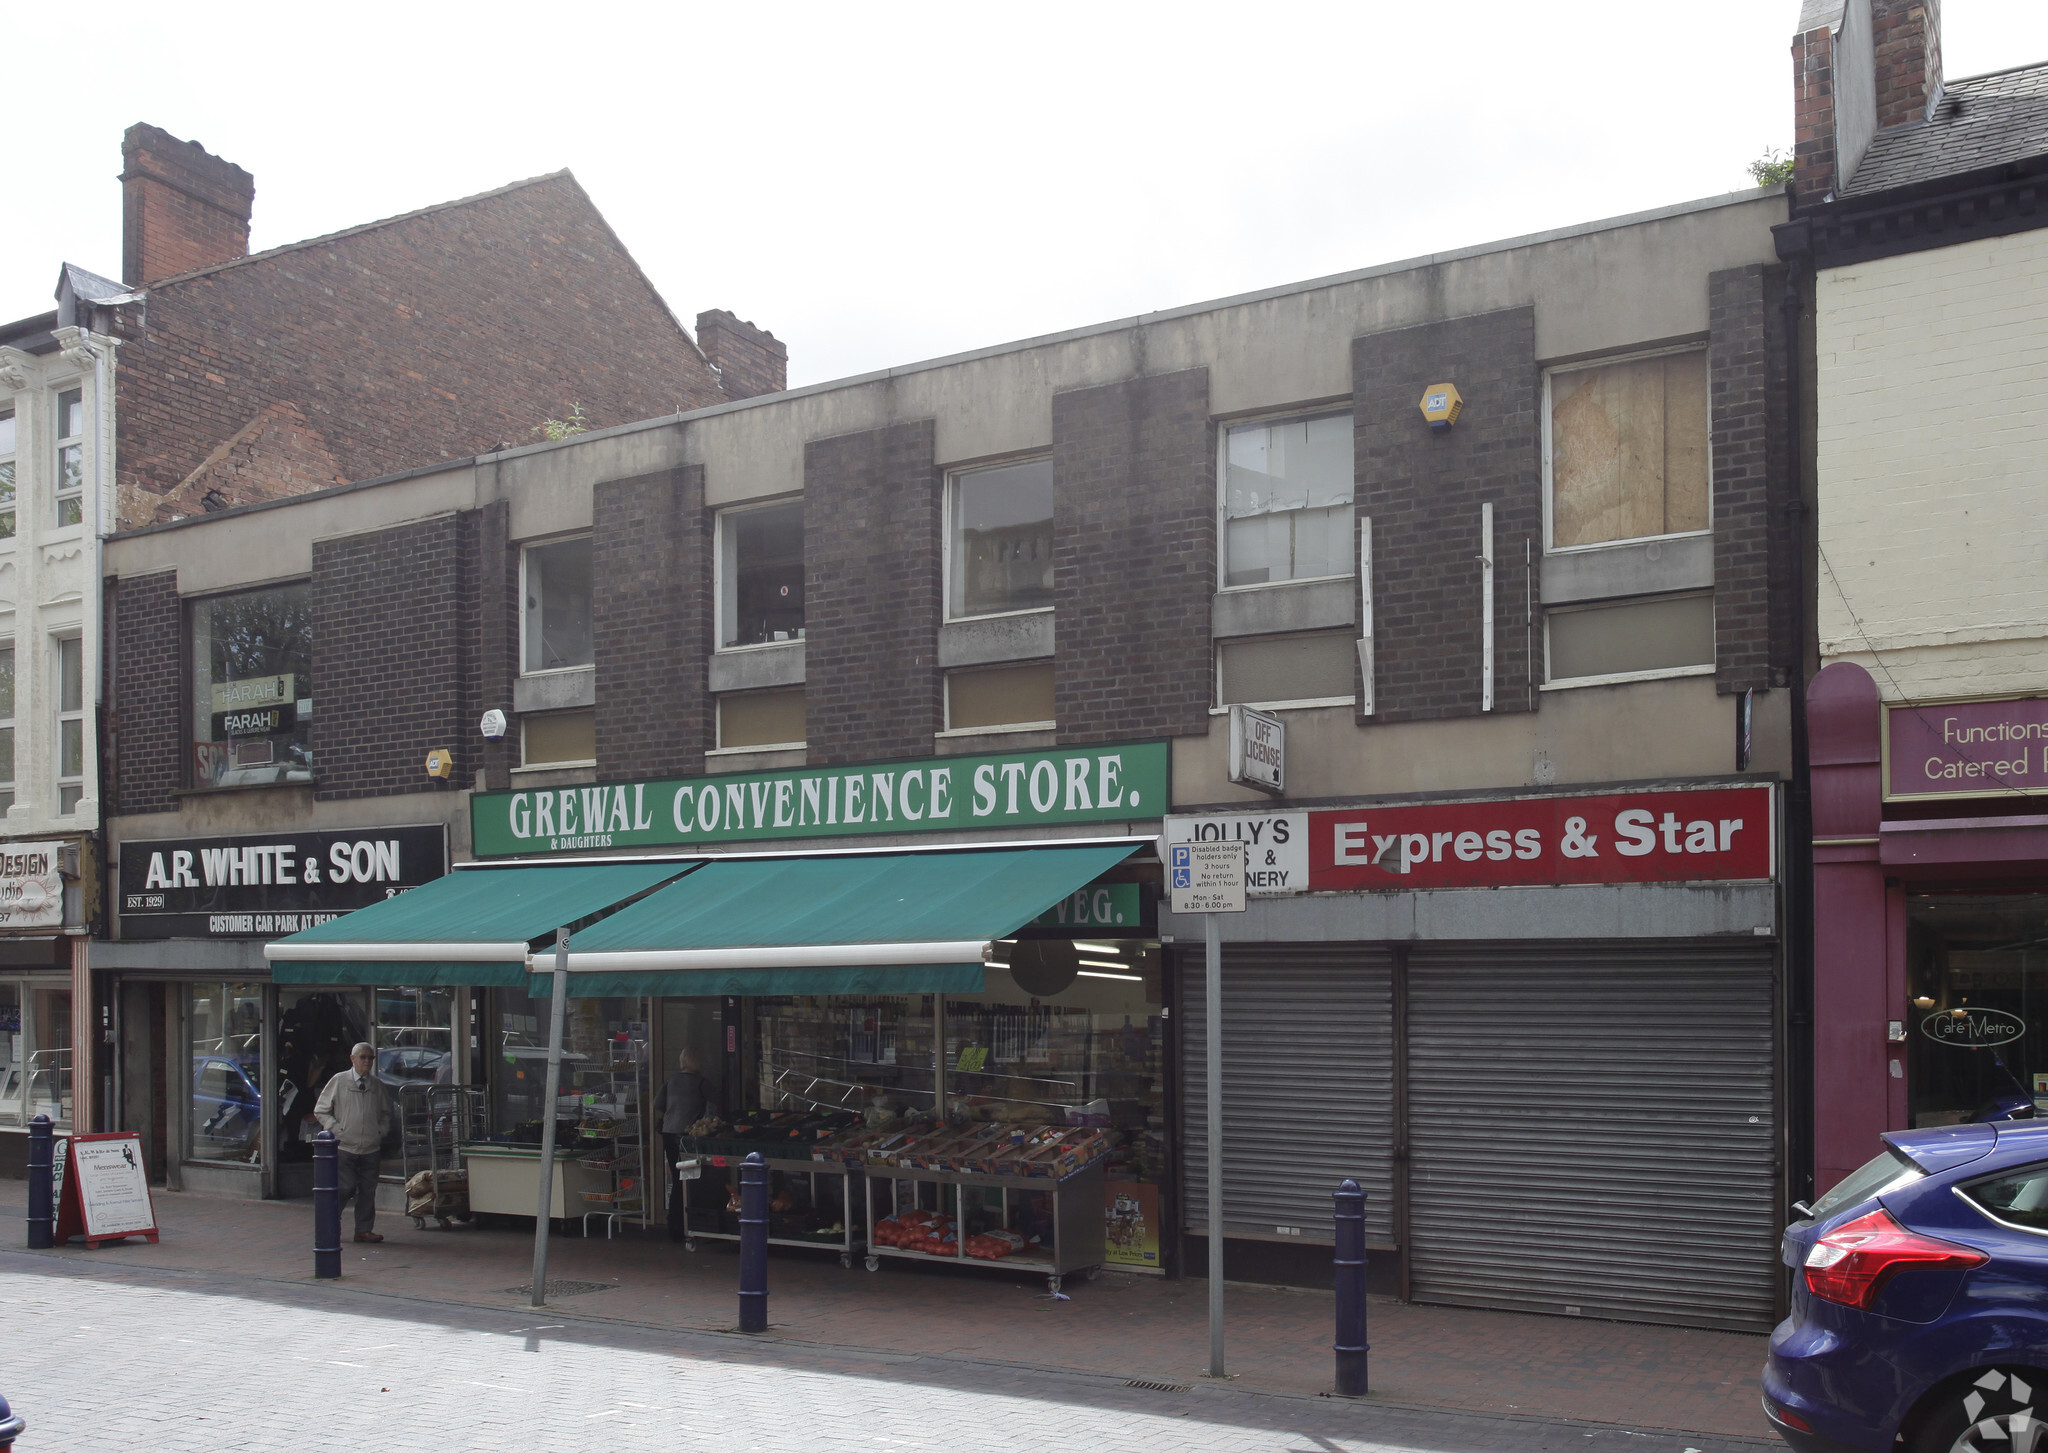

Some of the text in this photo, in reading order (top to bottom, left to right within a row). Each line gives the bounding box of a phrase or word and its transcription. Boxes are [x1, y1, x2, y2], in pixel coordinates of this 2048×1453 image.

[1428, 397, 1446, 408] ADT
[222, 682, 276, 704] FARAH
[224, 711, 271, 731] FARAH
[1944, 717, 2048, 744] Functions
[1255, 721, 1271, 744] OFF
[1245, 738, 1280, 769] LICENSE
[1924, 746, 2028, 780] Catered
[509, 754, 1140, 839] GREWAL CONVENIENCE STORE.
[550, 834, 613, 850] & DAUGHTERS
[1222, 845, 1242, 853] badge
[1334, 808, 1744, 874] Express & Star
[145, 840, 400, 889] A.R. WHITE & SON
[1176, 849, 1188, 866] P
[1265, 849, 1276, 866] &
[127, 895, 163, 908] EST. 1929
[1205, 901, 1221, 909] 6.00
[209, 914, 338, 933] CUSTOMER CAR PARK AT RE
[1934, 1015, 2016, 1039] Café Metro
[94, 1163, 127, 1171] Menswear
